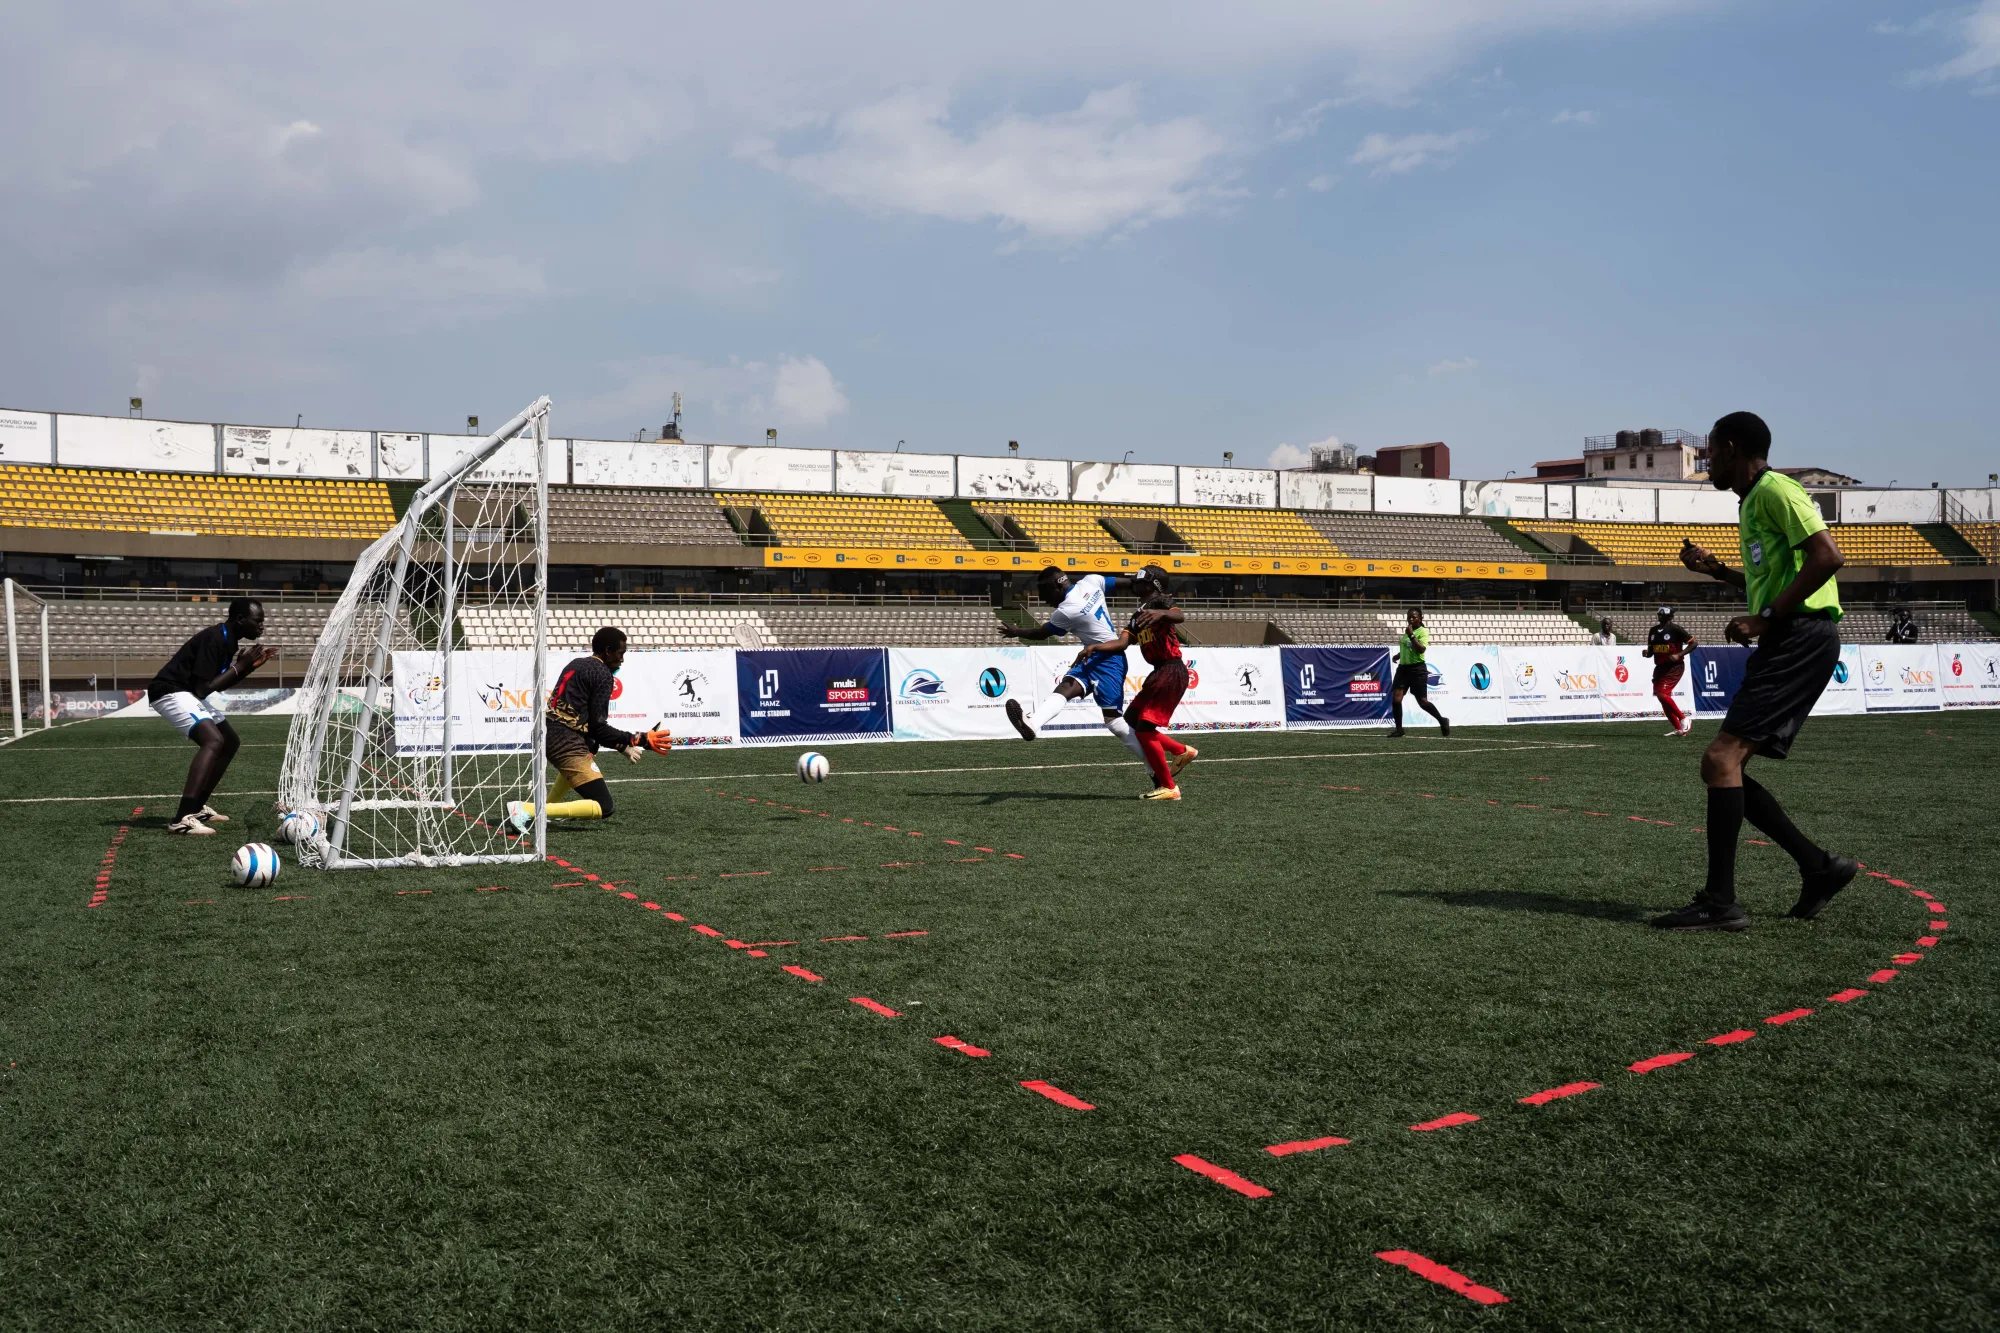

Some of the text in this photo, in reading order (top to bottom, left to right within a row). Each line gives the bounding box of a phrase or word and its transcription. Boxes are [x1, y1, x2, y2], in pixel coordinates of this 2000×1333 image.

[1094, 605, 1115, 633] 7
[672, 669, 709, 686] BLIND FOOTBALL
[833, 679, 856, 688] multi
[1568, 675, 1597, 689] NCS
[1910, 671, 1933, 684] NCS
[829, 691, 865, 699] SPORTS
[67, 701, 118, 710] BOXING
